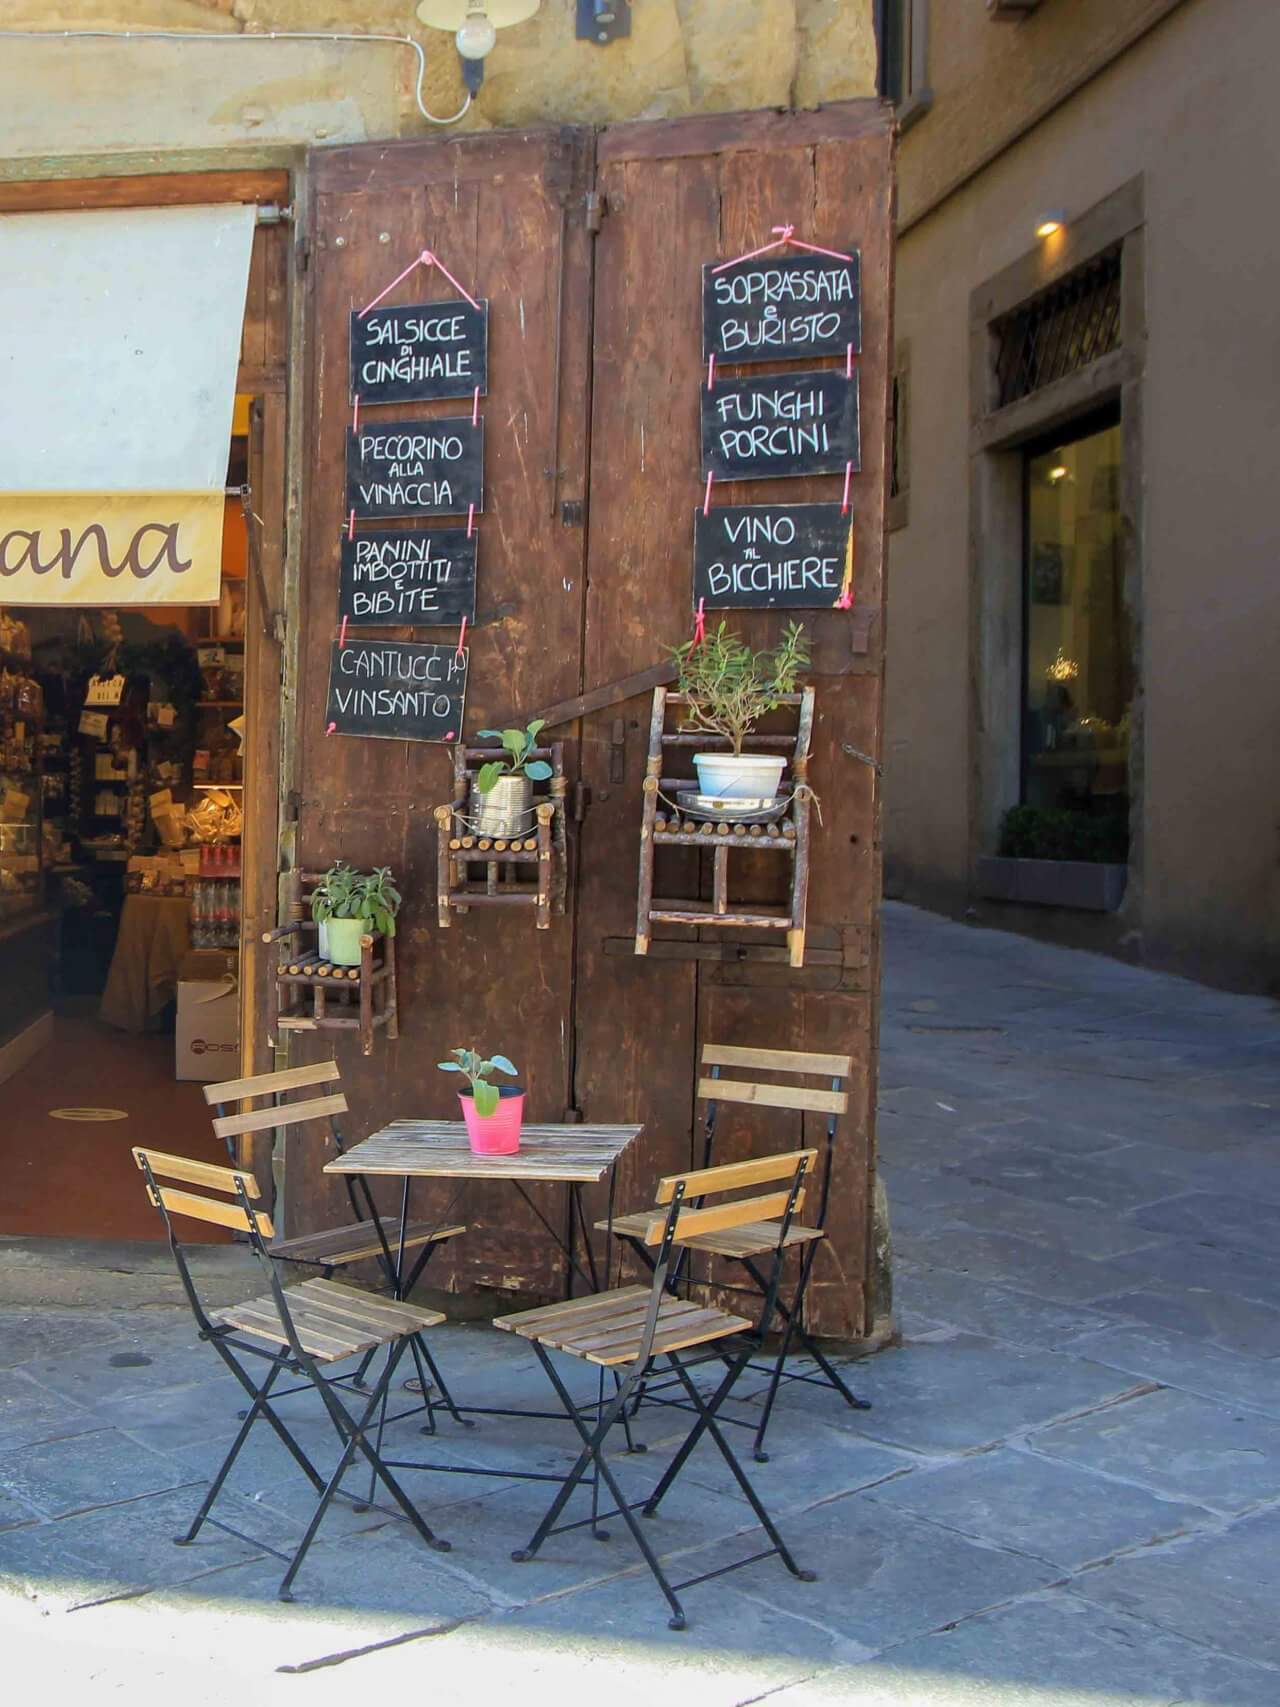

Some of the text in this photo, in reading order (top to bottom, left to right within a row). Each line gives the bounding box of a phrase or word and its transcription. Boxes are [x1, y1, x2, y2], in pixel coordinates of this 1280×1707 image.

[714, 268, 854, 304] SOPRASSATA
[365, 316, 467, 346] SALSICCE
[720, 312, 841, 352] BURISTO
[401, 344, 413, 356] DI
[362, 350, 471, 384] CINGHIALE
[716, 389, 824, 423] FUNGHI
[360, 436, 464, 461] PECORINO
[719, 423, 831, 459] PORCINI
[388, 462, 424, 478] ALLA
[359, 480, 453, 506] VINACCIA
[723, 514, 796, 545] VINO
[355, 539, 432, 562] PANINI
[353, 559, 453, 583] IMBOTTITI
[395, 579, 405, 590] E
[707, 556, 839, 596] BICCHIERE
[353, 587, 440, 616] BIBITE
[335, 687, 451, 718] VINSANTO
